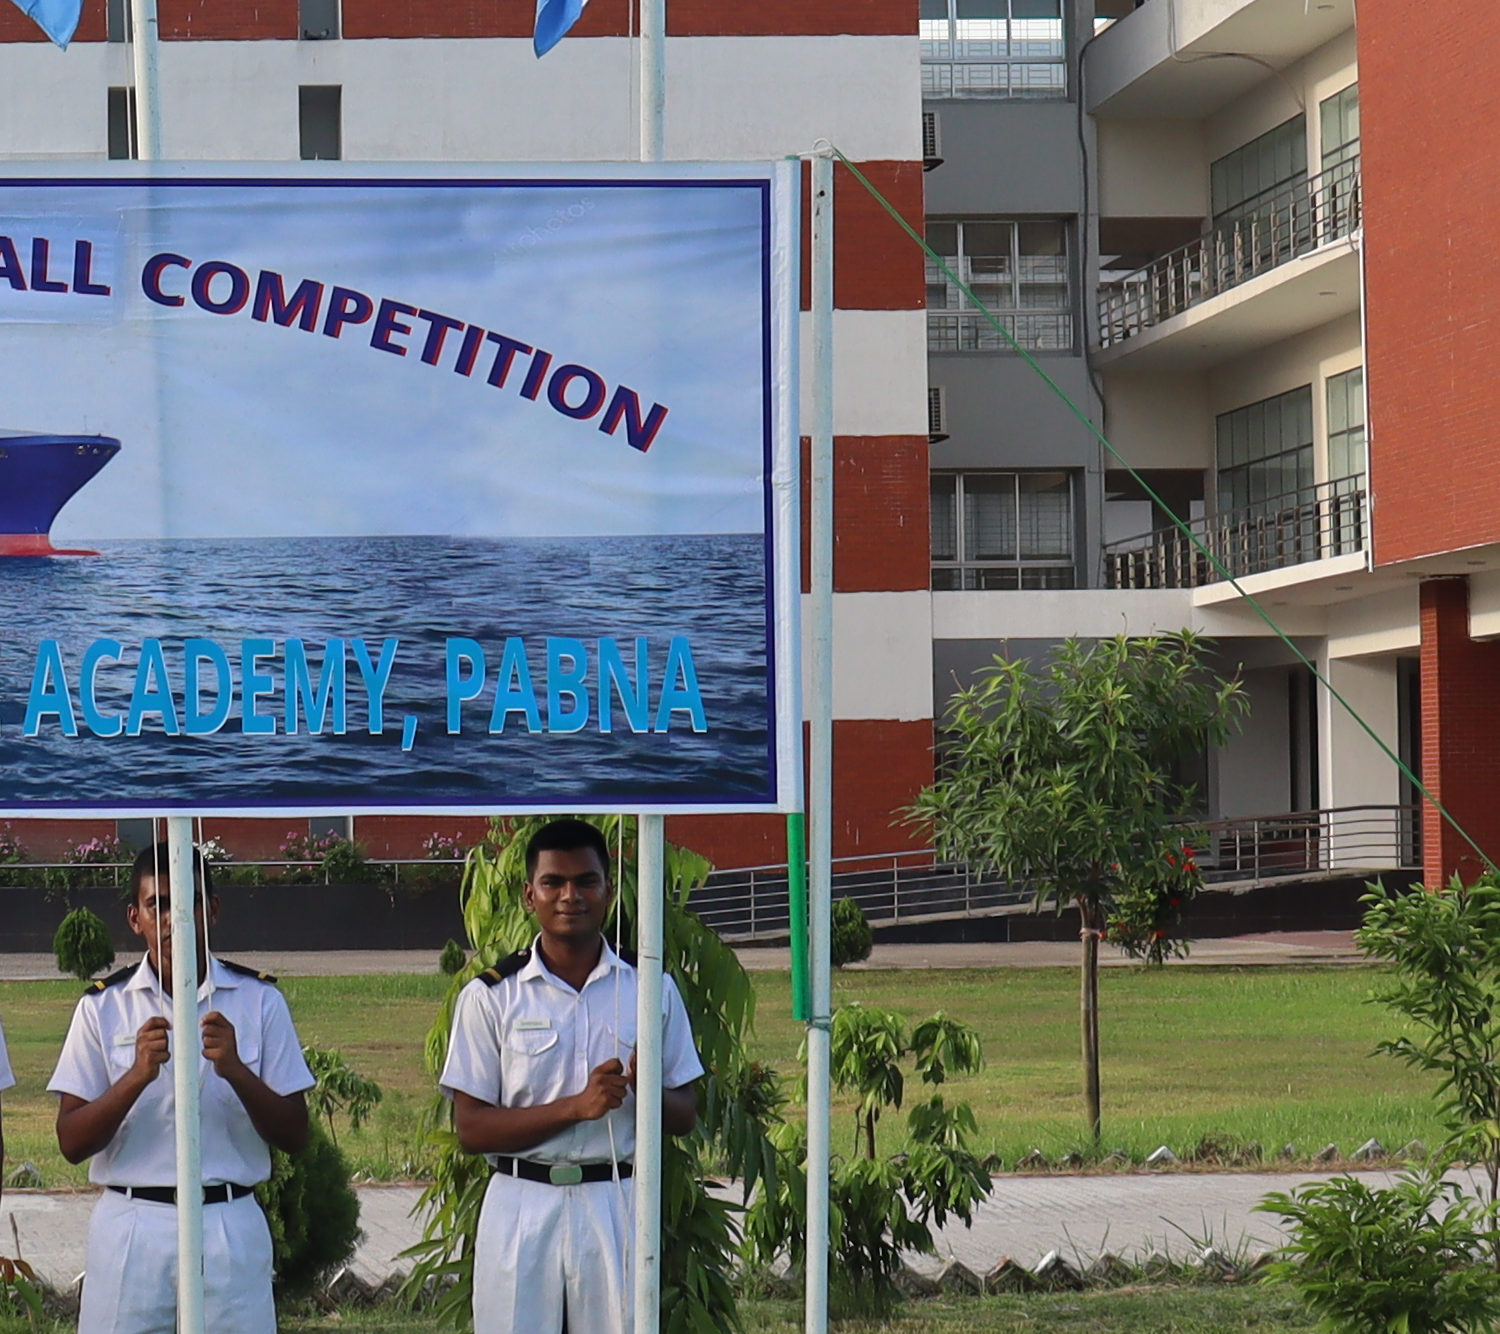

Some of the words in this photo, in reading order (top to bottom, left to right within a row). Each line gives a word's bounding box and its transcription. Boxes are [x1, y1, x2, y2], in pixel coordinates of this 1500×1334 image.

[141, 252, 669, 454] COMPETITION
[22, 638, 418, 751] ACADEMY,
[445, 636, 710, 734] PABNA
